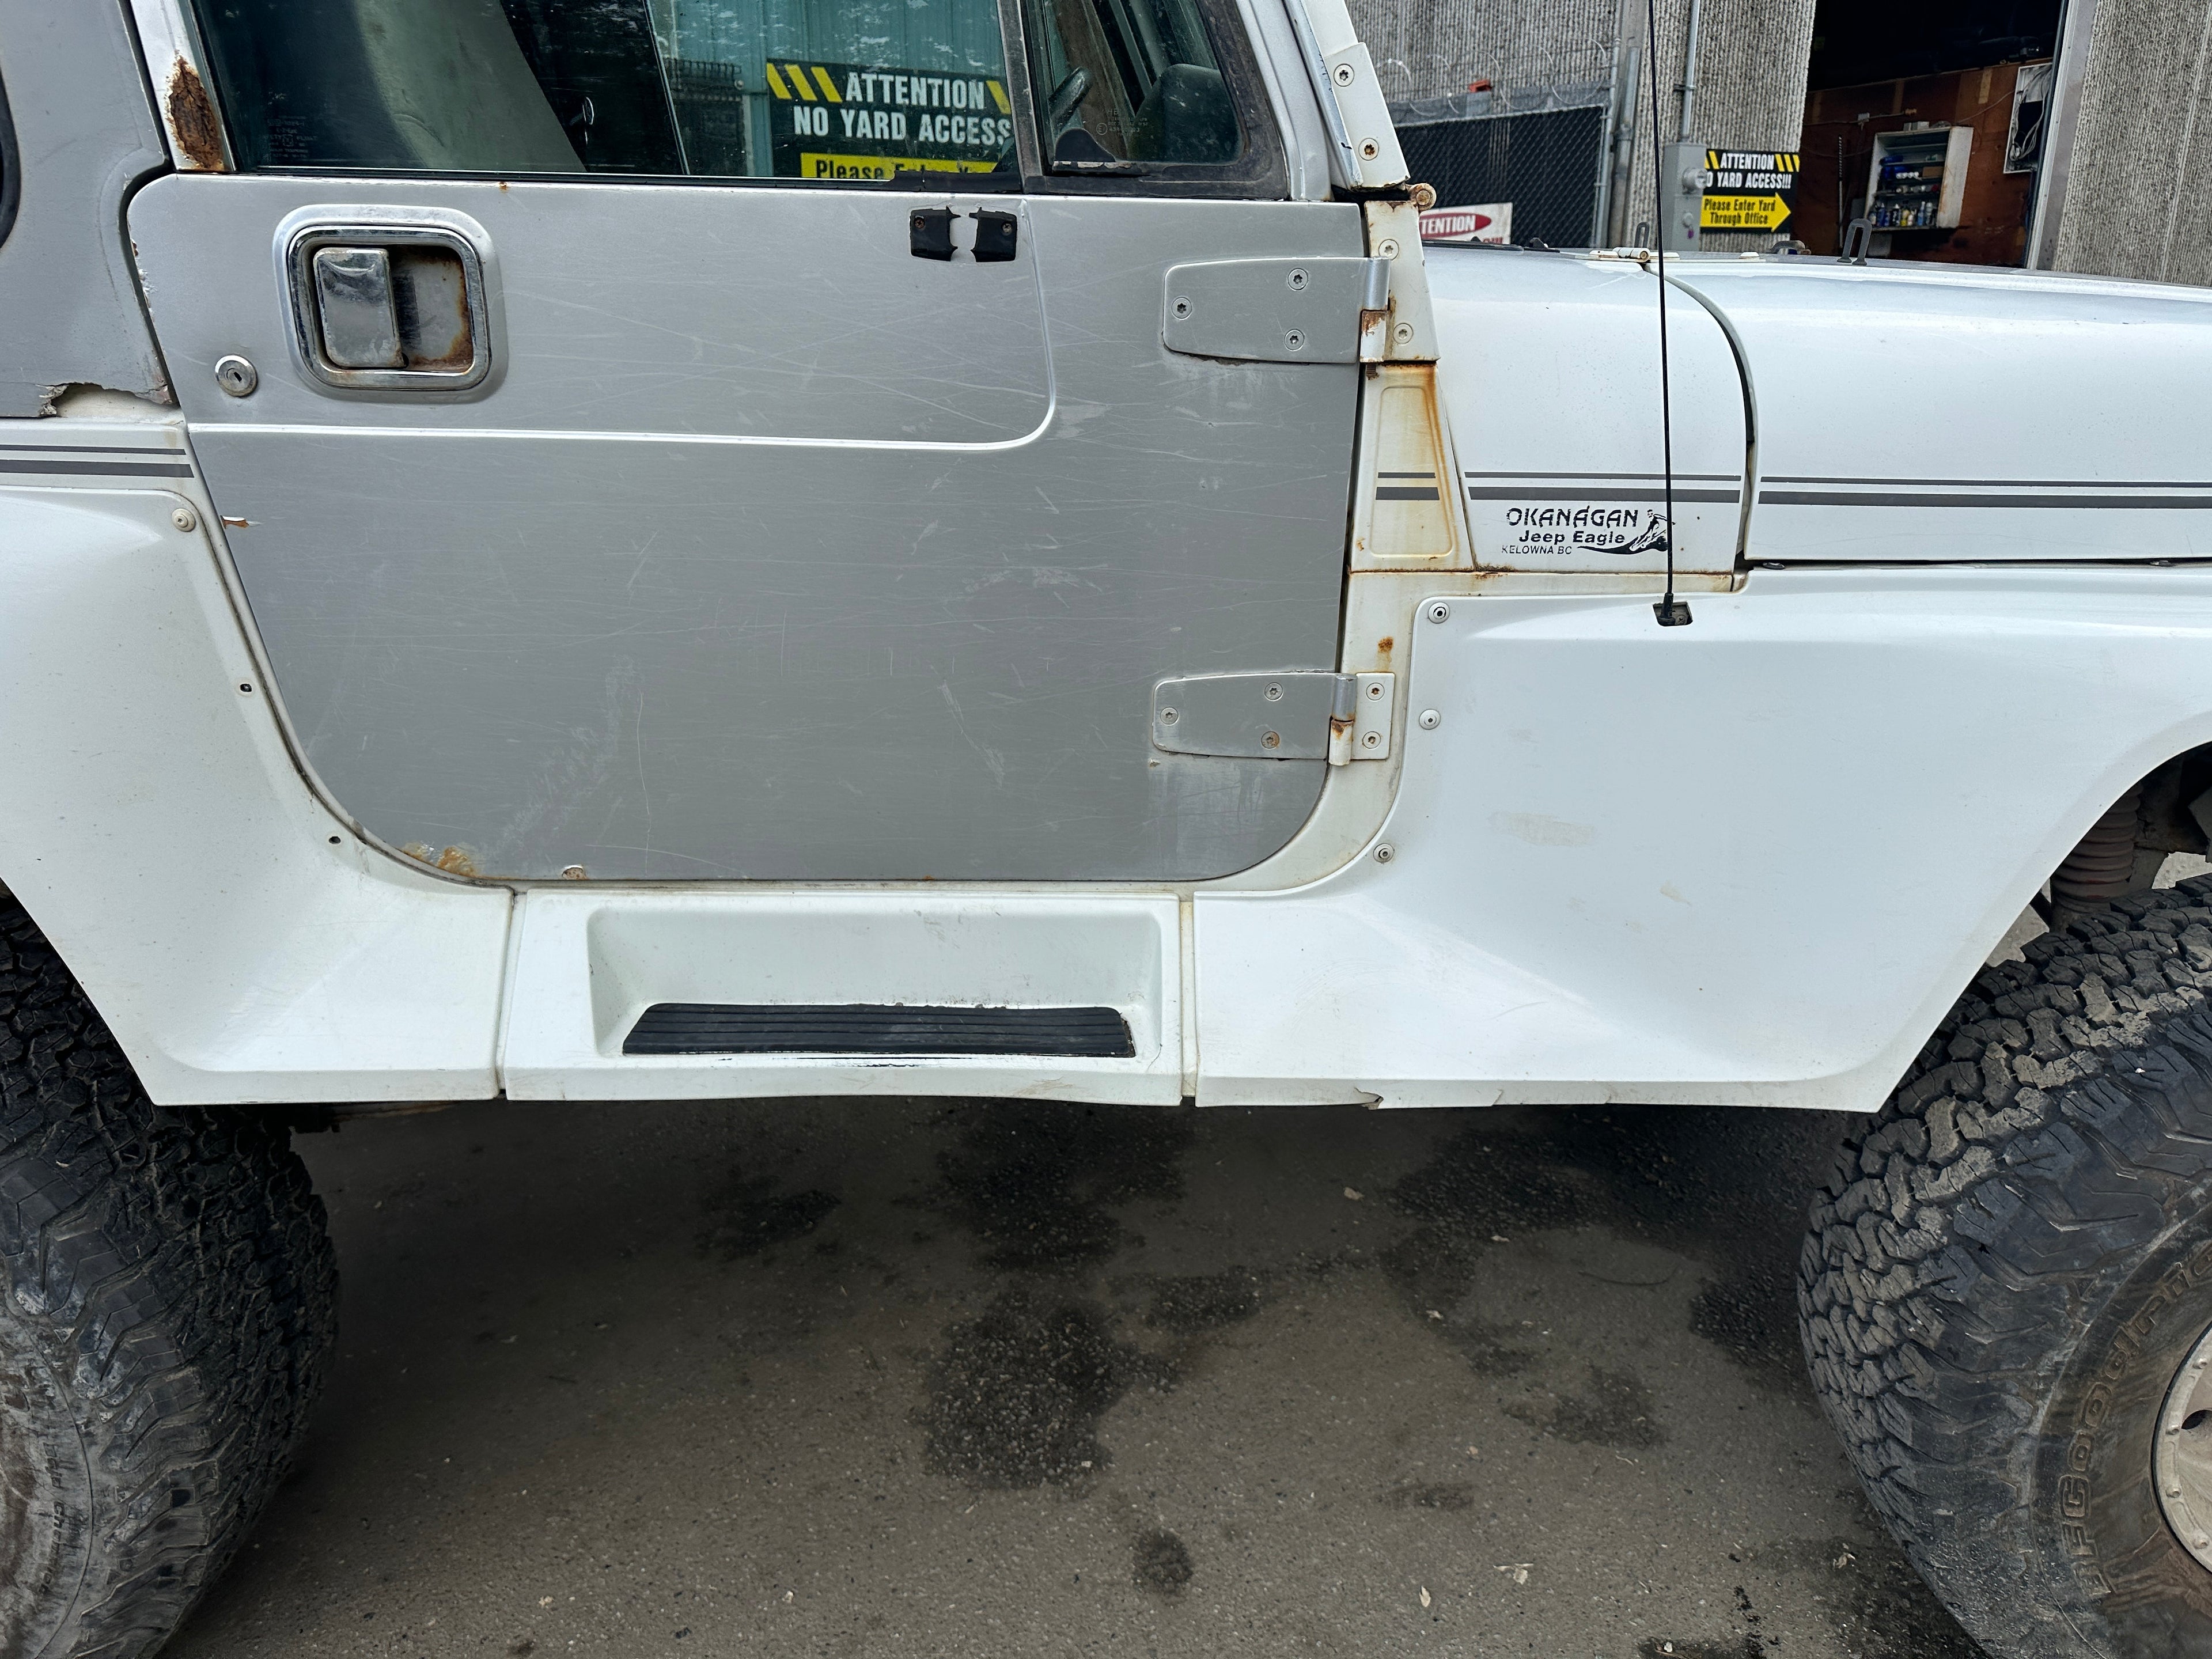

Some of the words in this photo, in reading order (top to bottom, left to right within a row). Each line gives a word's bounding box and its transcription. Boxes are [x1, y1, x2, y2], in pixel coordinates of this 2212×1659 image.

[846, 72, 984, 110] ATTENTION
[794, 105, 829, 137] NO
[840, 108, 906, 140] YARD
[816, 160, 884, 179] Please
[1720, 153, 1774, 170] ATTENTION
[1707, 172, 1714, 187] O
[1717, 172, 1743, 188] YARD
[1745, 173, 1791, 189] ACCESS!!!
[1704, 199, 1731, 211] Please
[1734, 199, 1755, 211] Enter
[1759, 200, 1776, 211] Yard
[1420, 215, 1476, 234] TENTION
[1710, 212, 1741, 226] Through
[1745, 213, 1768, 224] Office
[1506, 506, 1638, 528] OKANAGAN
[1519, 531, 1565, 546] Jeep
[1573, 531, 1625, 546] Eagle
[1501, 545, 1554, 554] KELOWNA
[1558, 546, 1573, 555] BC
